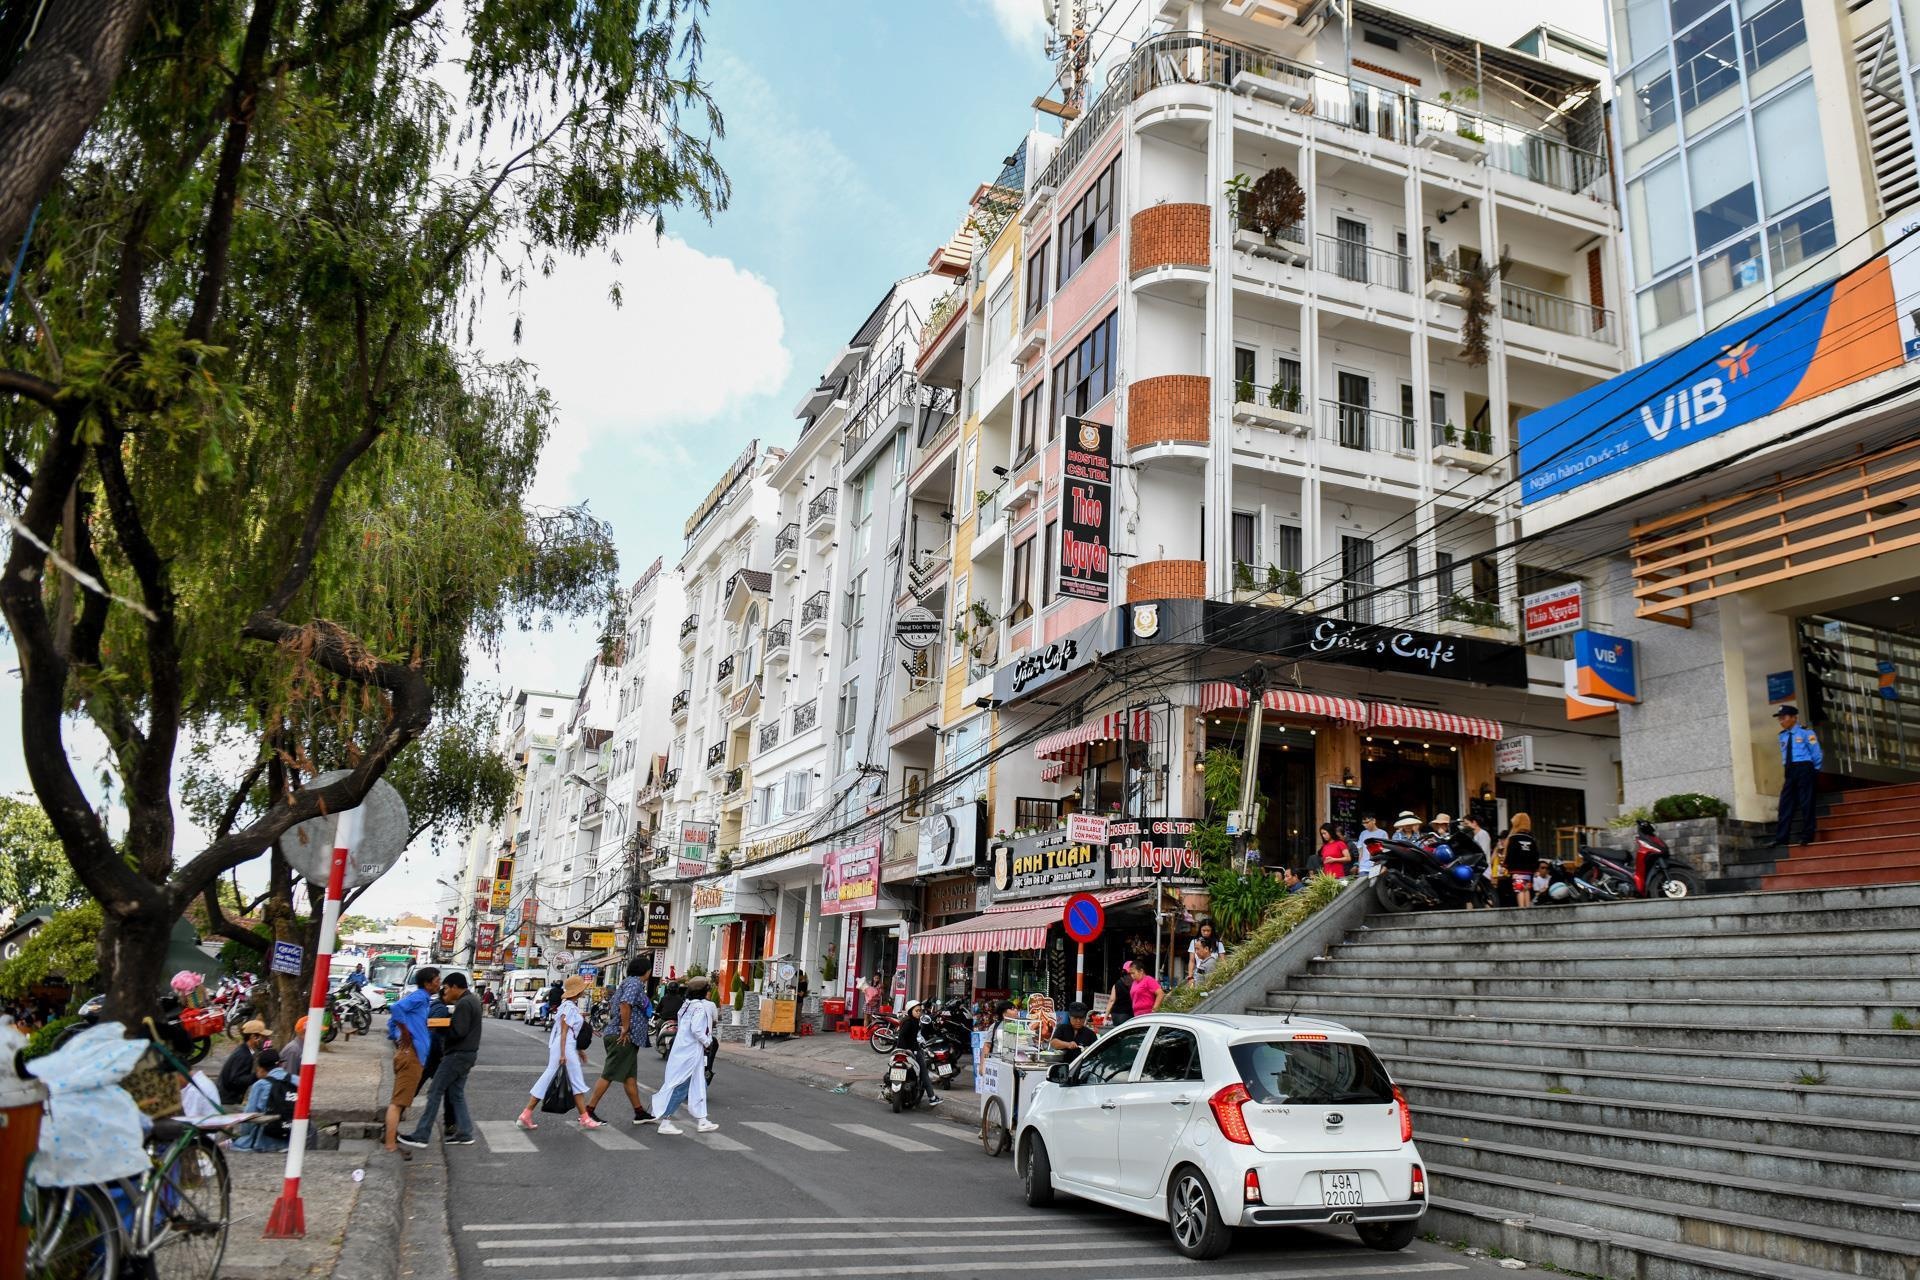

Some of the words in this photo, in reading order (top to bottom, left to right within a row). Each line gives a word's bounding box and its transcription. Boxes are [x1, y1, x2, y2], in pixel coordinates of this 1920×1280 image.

[1640, 378, 1727, 441] VIB
[1067, 450, 1109, 468] HOSTEL
[1067, 464, 1109, 482] CSLTDL
[1072, 486, 1102, 528] Thảo
[1063, 530, 1107, 579] Nguyên
[1391, 633, 1456, 669] Café
[1594, 647, 1617, 663] VIB
[1076, 825, 1102, 833] AVAILABLE
[1109, 823, 1141, 836] HOSTEL
[1013, 853, 1043, 875] ANH
[1110, 838, 1140, 869] Thảo
[1141, 841, 1200, 874] Nguyên
[1329, 1114, 1342, 1124] KIA
[1332, 1174, 1352, 1189] 49A
[1326, 1191, 1362, 1206] 220.02
